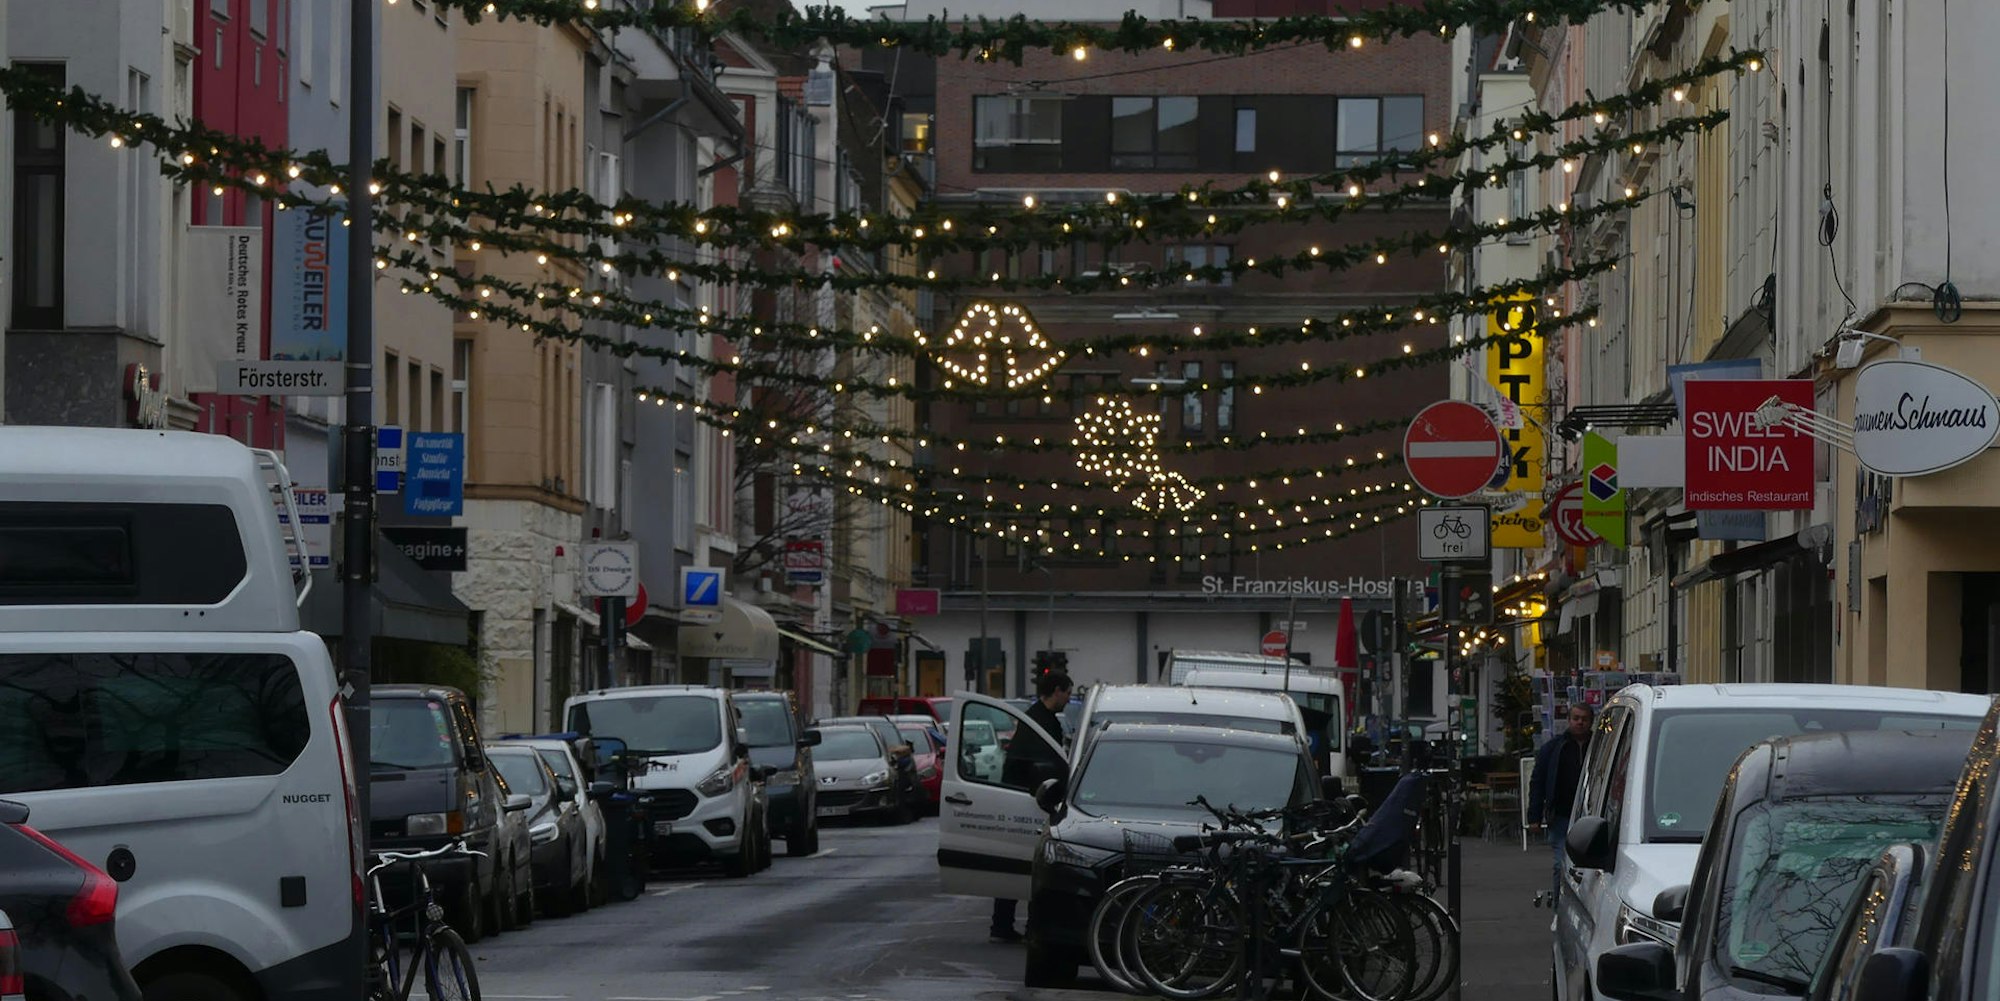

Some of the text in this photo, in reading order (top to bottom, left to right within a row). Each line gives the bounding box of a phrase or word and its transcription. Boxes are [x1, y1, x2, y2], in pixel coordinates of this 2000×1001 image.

[236, 235, 250, 354] Deutsches Rotes Kreuz
[239, 367, 327, 388] Försterstr.
[1707, 445, 1790, 472] INDIA
[1747, 490, 1809, 502] Restaurant
[1443, 541, 1463, 553] frei
[283, 794, 331, 803] NUGGET
